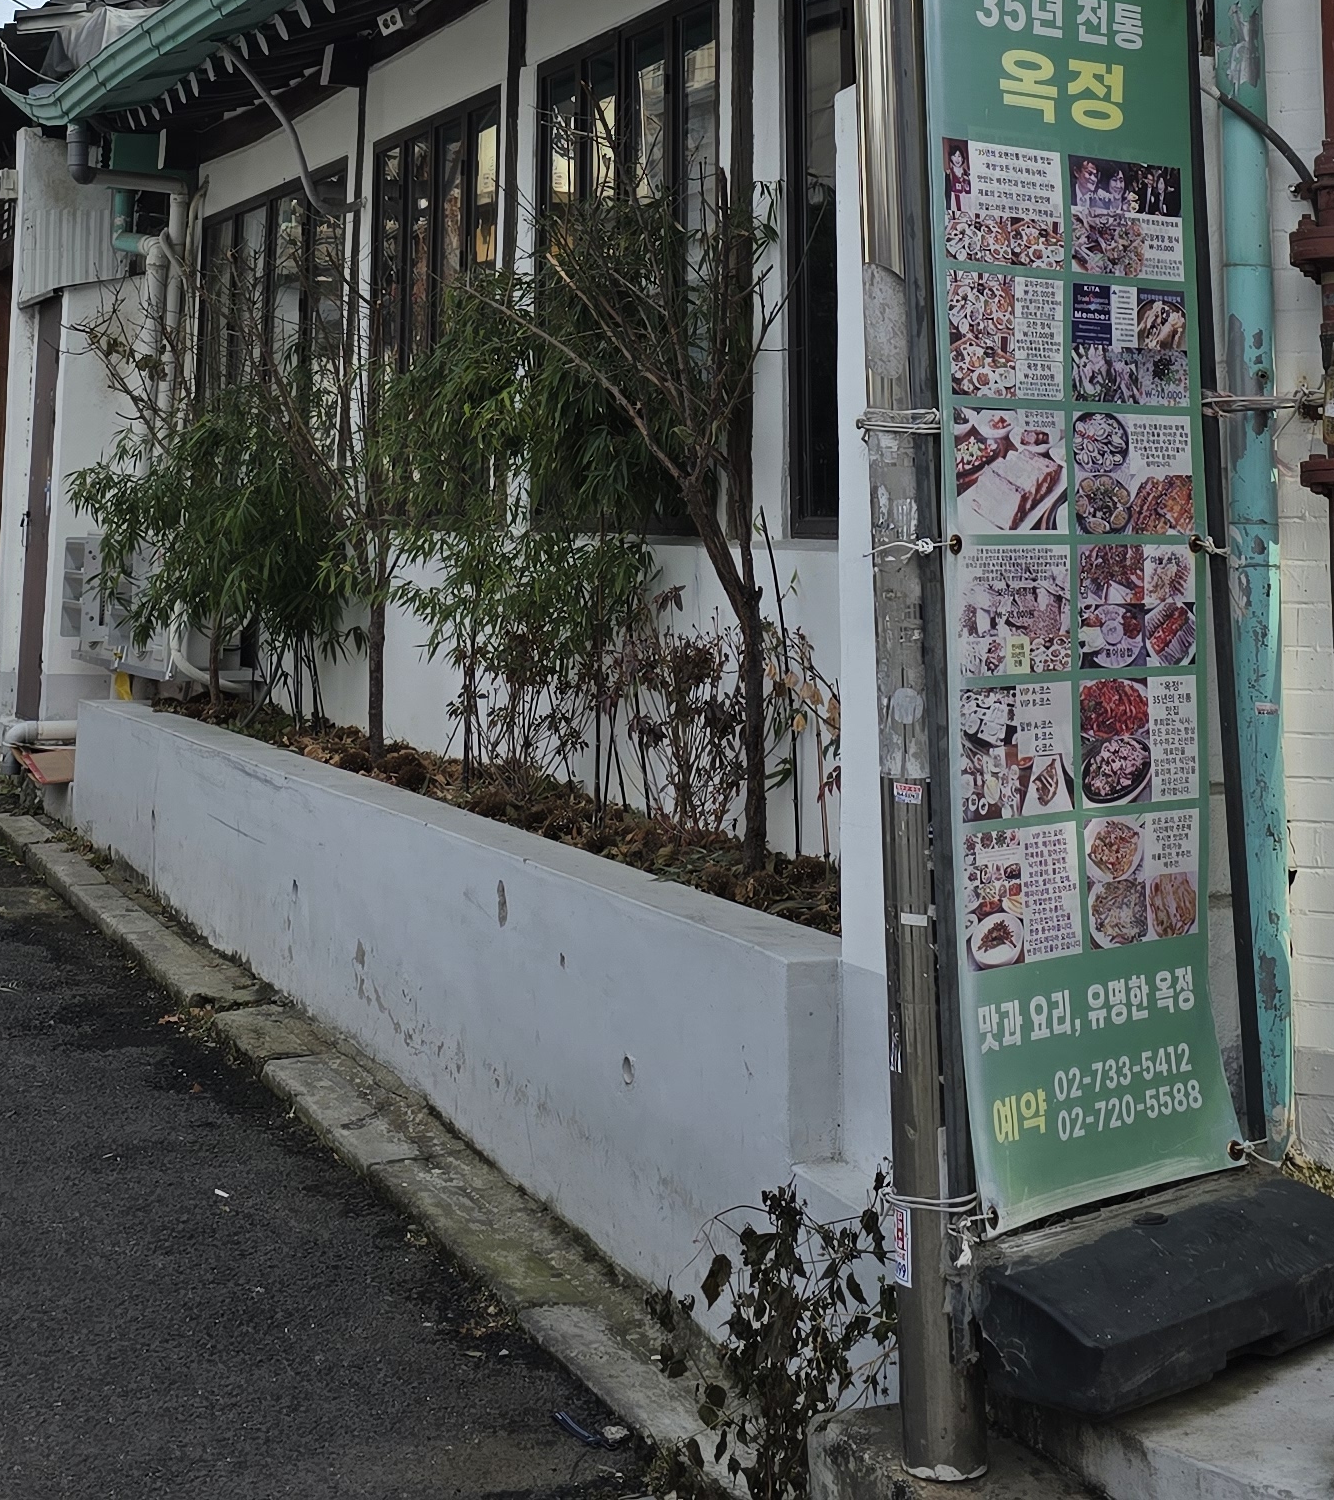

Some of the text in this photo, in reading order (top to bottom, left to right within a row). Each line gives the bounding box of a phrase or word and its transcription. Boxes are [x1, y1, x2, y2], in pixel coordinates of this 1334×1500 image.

[999, 49, 1124, 131] 옥정
[1074, 311, 1109, 320] Member
[978, 1000, 1023, 1054] 맛과
[1087, 974, 1149, 1030] 유명한
[1155, 966, 1195, 1014] 옥정
[1054, 1042, 1192, 1102] 02-733-5412
[993, 1088, 1047, 1144] 예약
[1057, 1080, 1203, 1141] 02-720-5588
